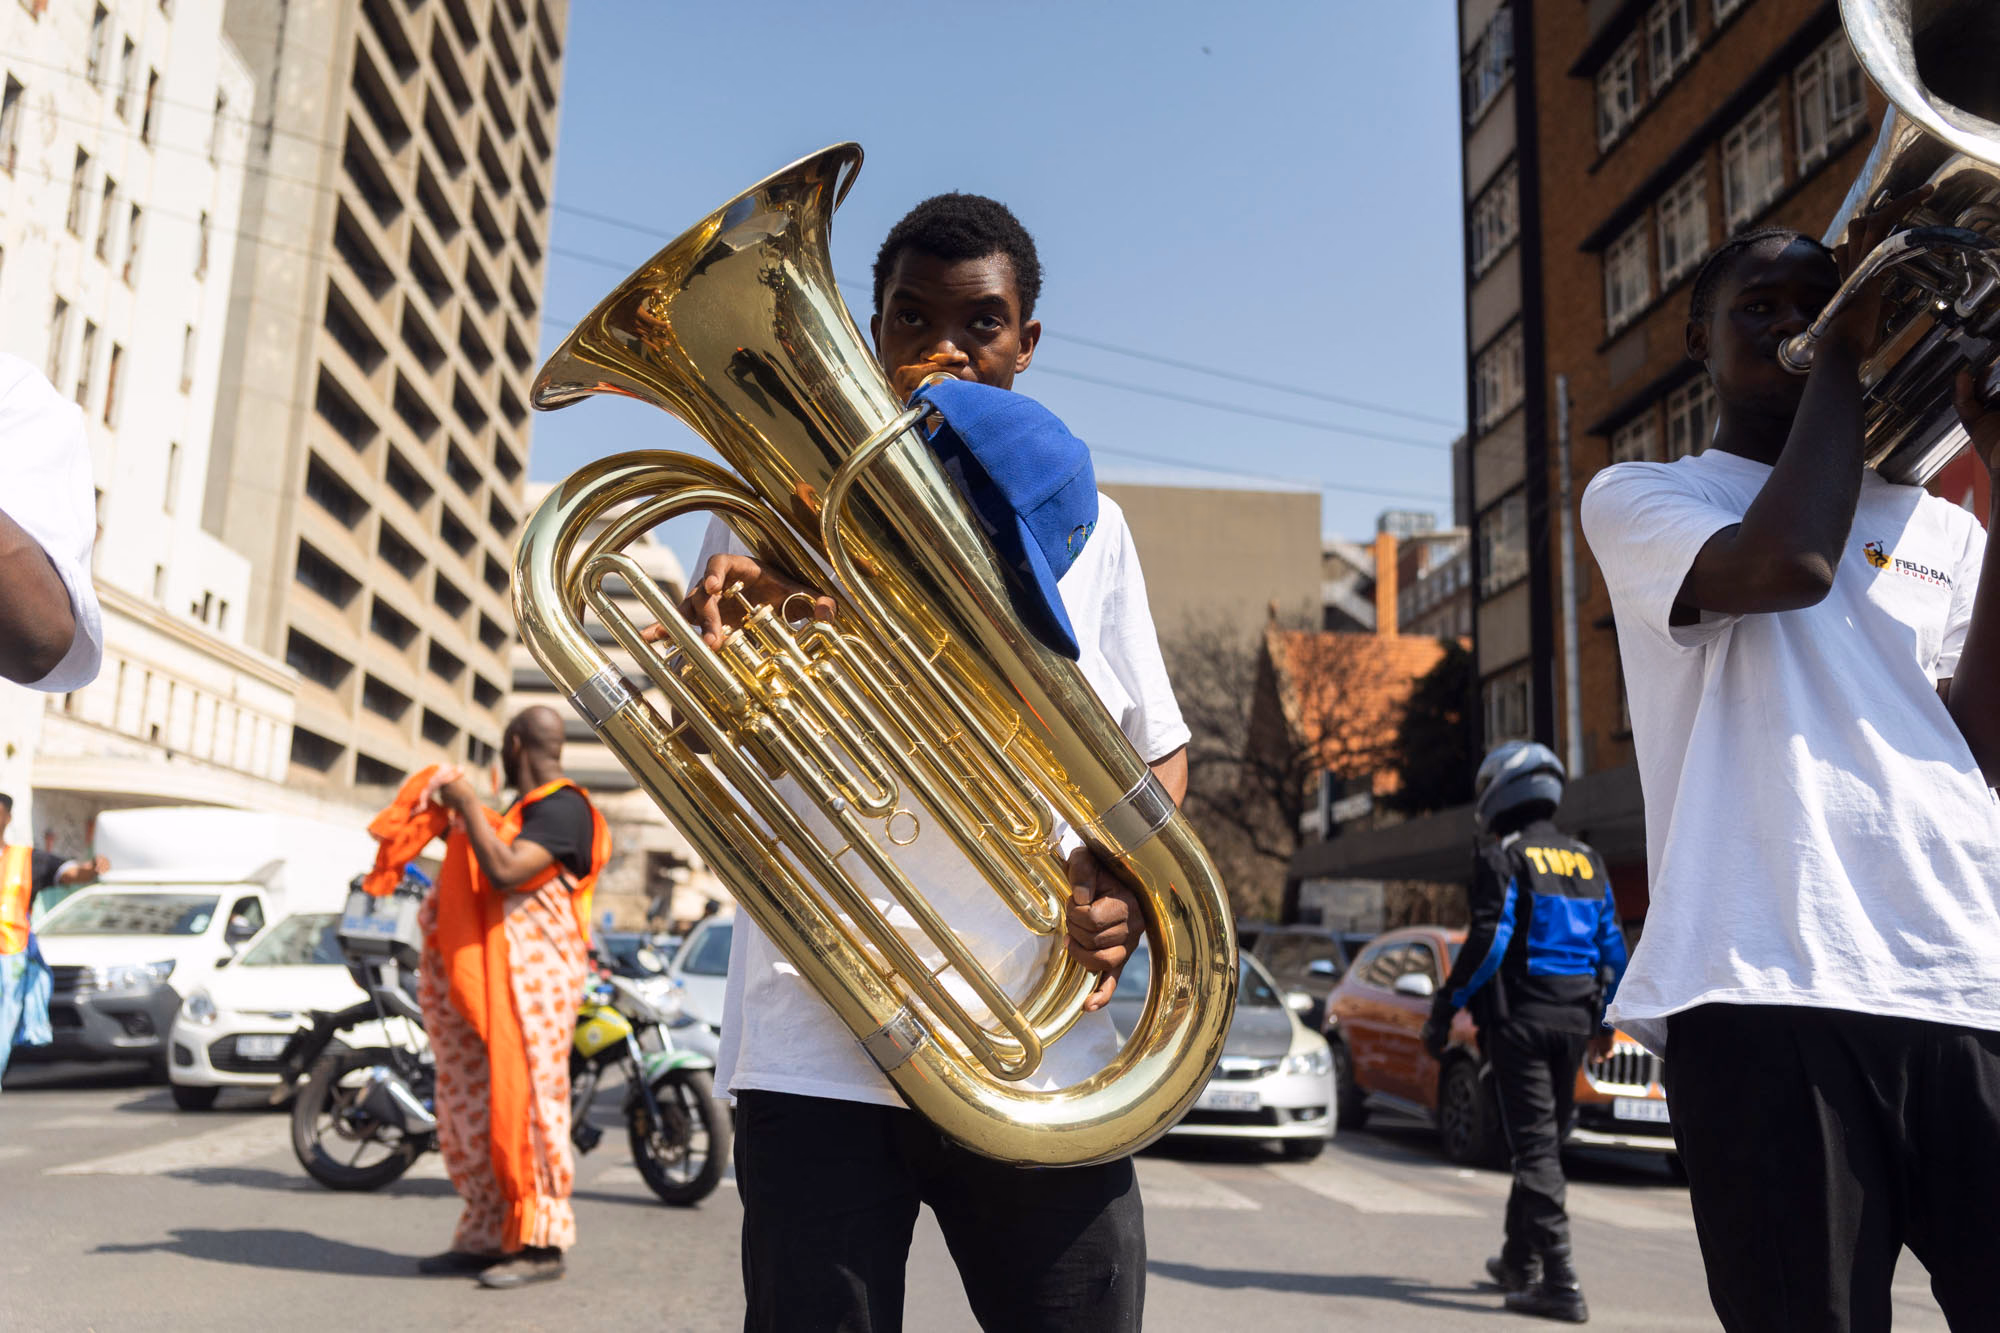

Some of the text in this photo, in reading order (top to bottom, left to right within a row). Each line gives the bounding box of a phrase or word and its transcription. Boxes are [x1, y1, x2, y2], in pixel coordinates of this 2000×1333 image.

[1895, 558, 1954, 591] FIELD BAN
[1895, 567, 1951, 592] FOUNDAT
